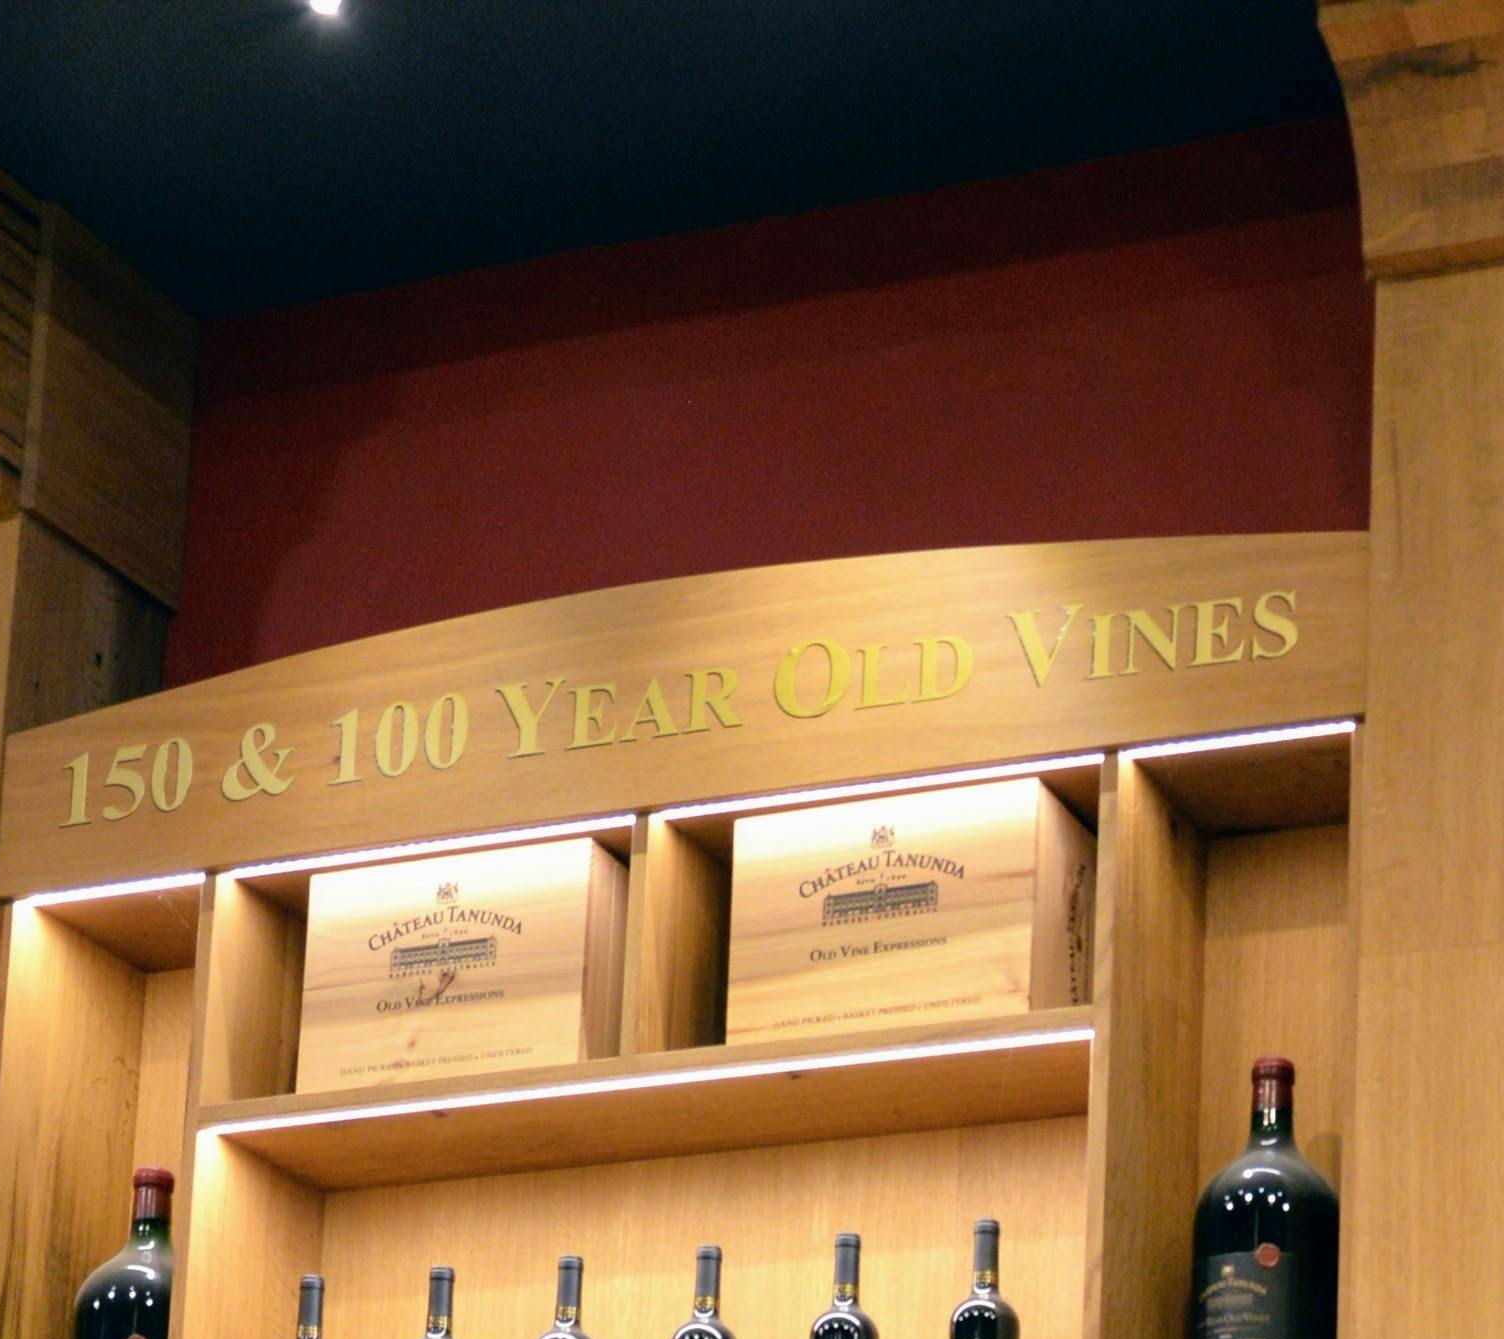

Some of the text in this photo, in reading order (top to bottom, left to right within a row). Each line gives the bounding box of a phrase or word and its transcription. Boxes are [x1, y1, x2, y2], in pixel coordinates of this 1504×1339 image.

[61, 590, 1299, 828] 150 & 100 YEAR OLD VINES
[799, 850, 966, 899] CHÂTEAU TANUNDA
[368, 905, 523, 951] CHÂTEAU TANUNDA
[810, 948, 837, 963] OLD
[840, 945, 871, 959] VINE
[376, 999, 402, 1013] OLD
